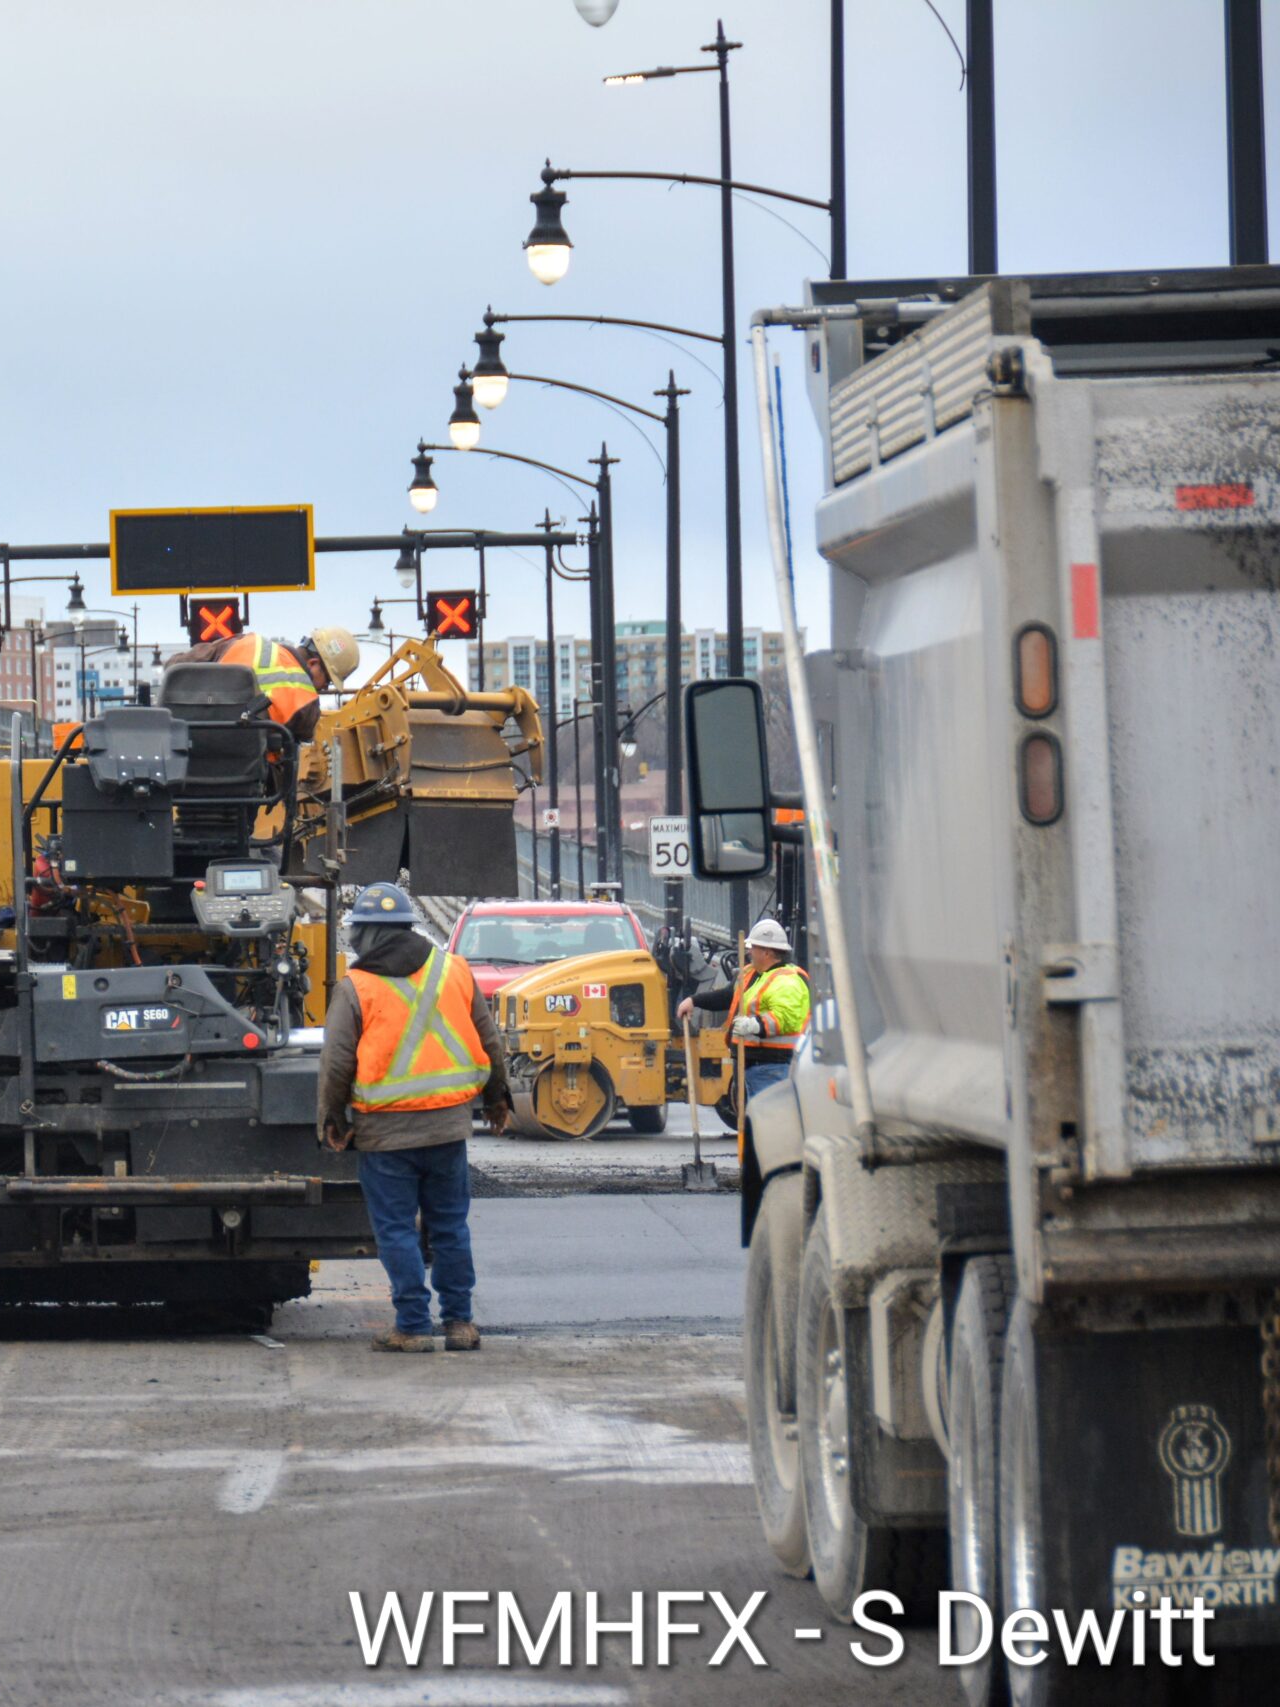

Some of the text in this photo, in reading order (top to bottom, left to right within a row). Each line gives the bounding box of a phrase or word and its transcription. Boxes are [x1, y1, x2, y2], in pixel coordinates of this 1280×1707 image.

[653, 824, 689, 832] MAXIMU
[656, 842, 690, 867] 50
[546, 994, 573, 1012] CAT
[105, 1009, 169, 1029] CAT SE60
[1114, 1543, 1280, 1582] Bayview
